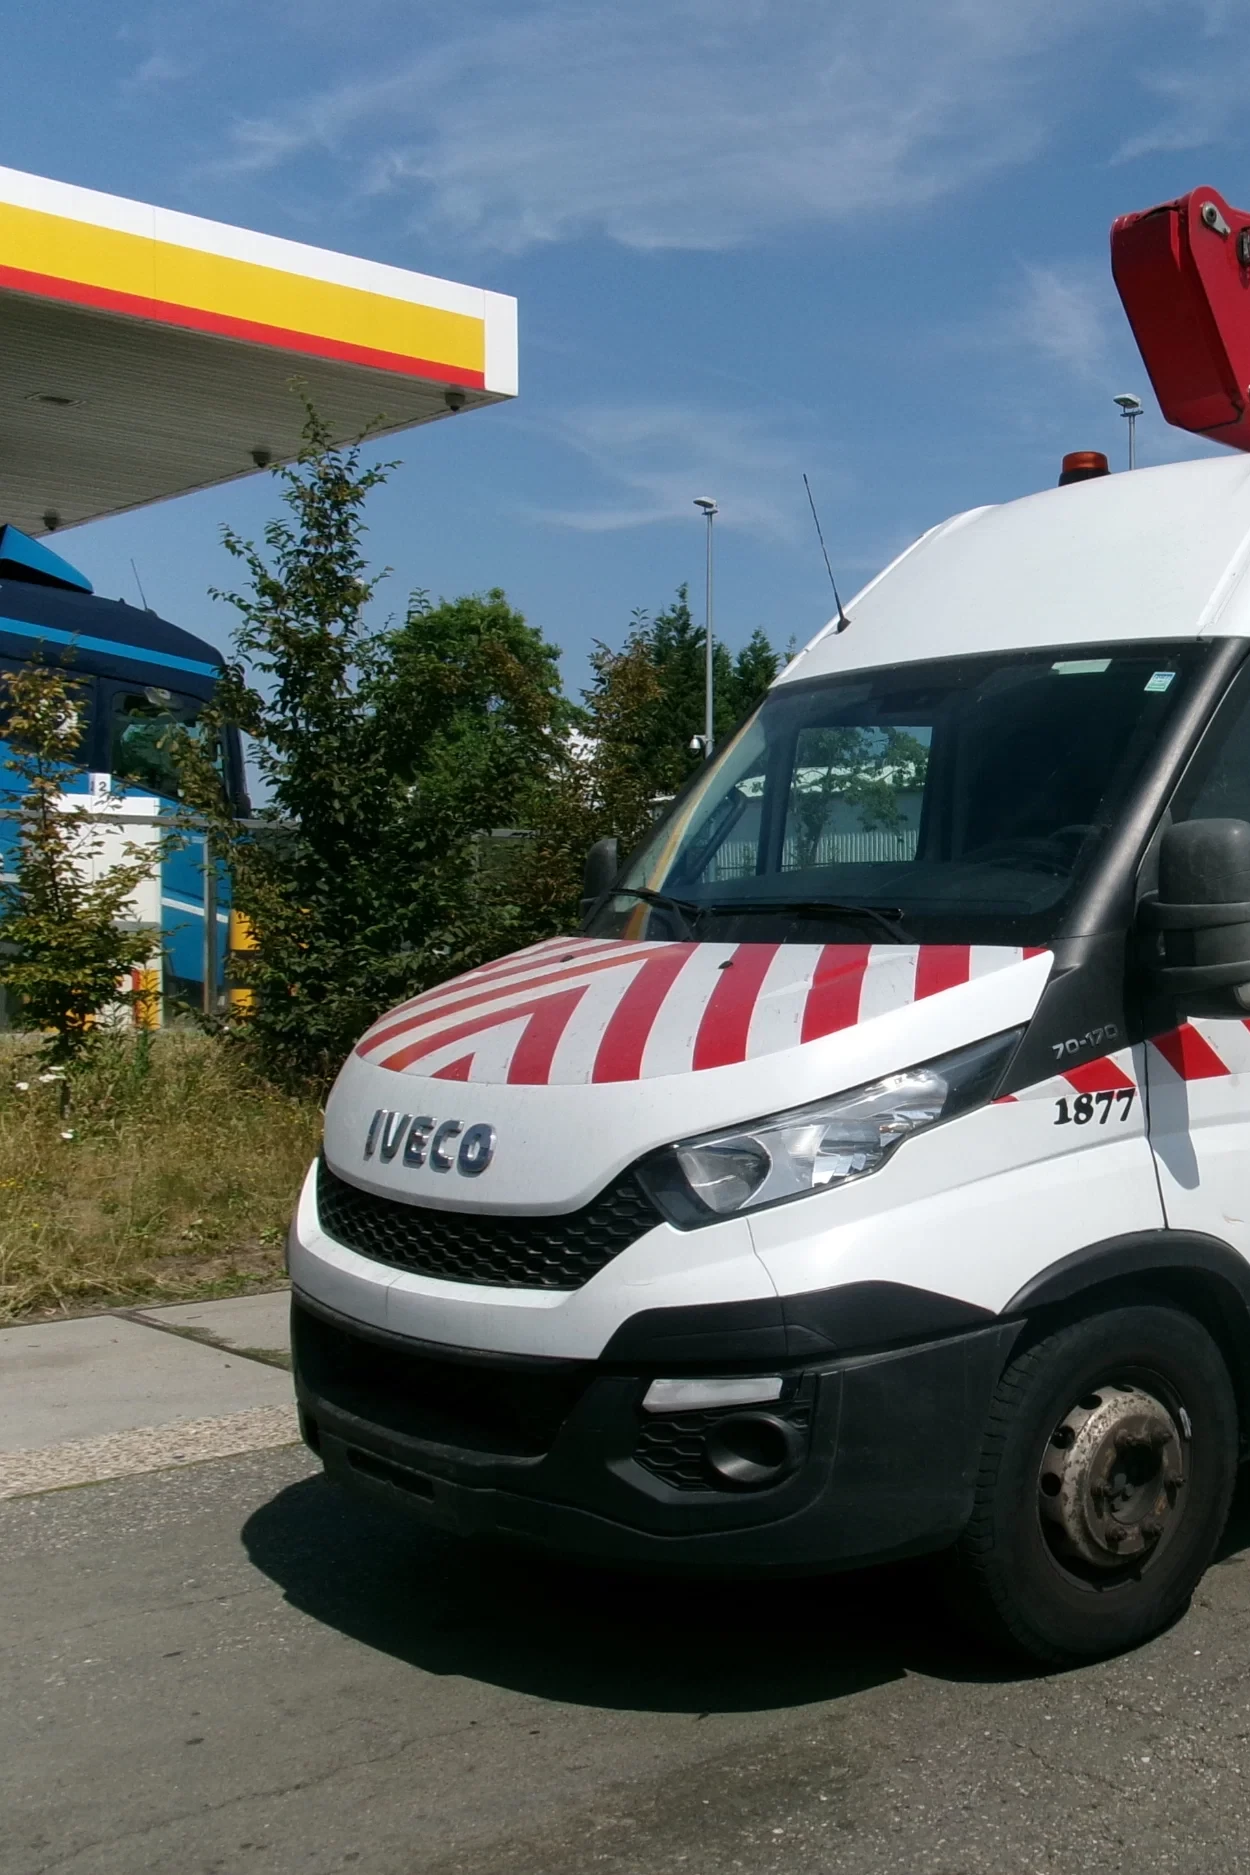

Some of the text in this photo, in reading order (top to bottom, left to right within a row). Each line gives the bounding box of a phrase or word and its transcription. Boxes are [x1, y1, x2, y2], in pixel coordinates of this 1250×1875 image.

[98, 781, 107, 792] 2
[1052, 1024, 1118, 1060] 70-170
[1053, 1088, 1136, 1125] 1877
[364, 1109, 497, 1177] IVECO
